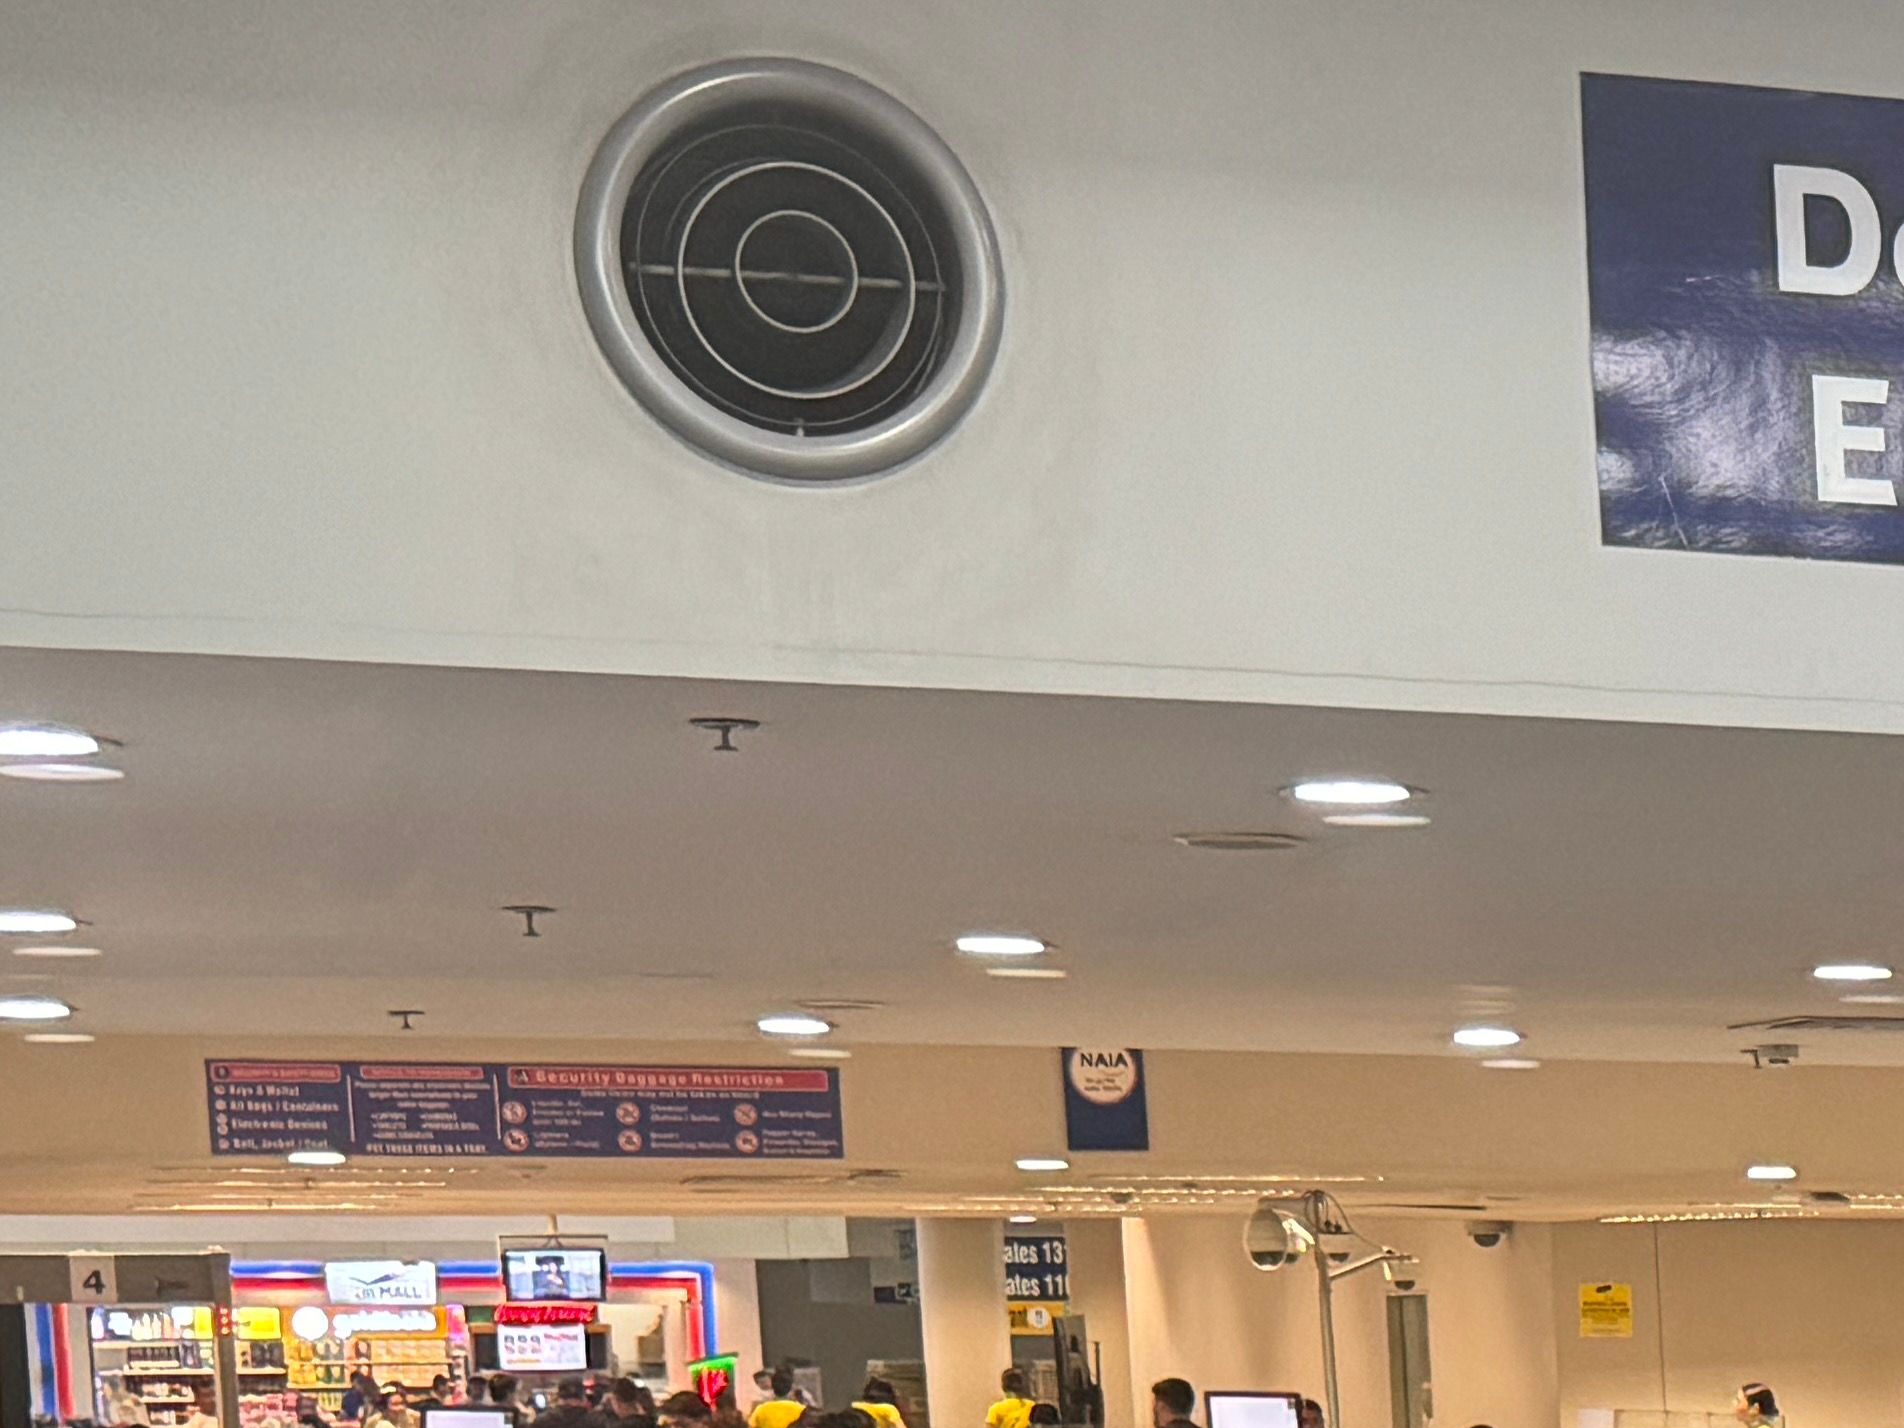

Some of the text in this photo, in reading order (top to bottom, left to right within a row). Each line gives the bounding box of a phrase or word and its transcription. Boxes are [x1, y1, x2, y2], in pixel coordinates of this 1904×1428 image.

[1080, 1053, 1128, 1067] NAIA
[536, 1071, 610, 1084] Security
[1042, 1241, 1067, 1264] 13
[83, 1270, 106, 1294] 4
